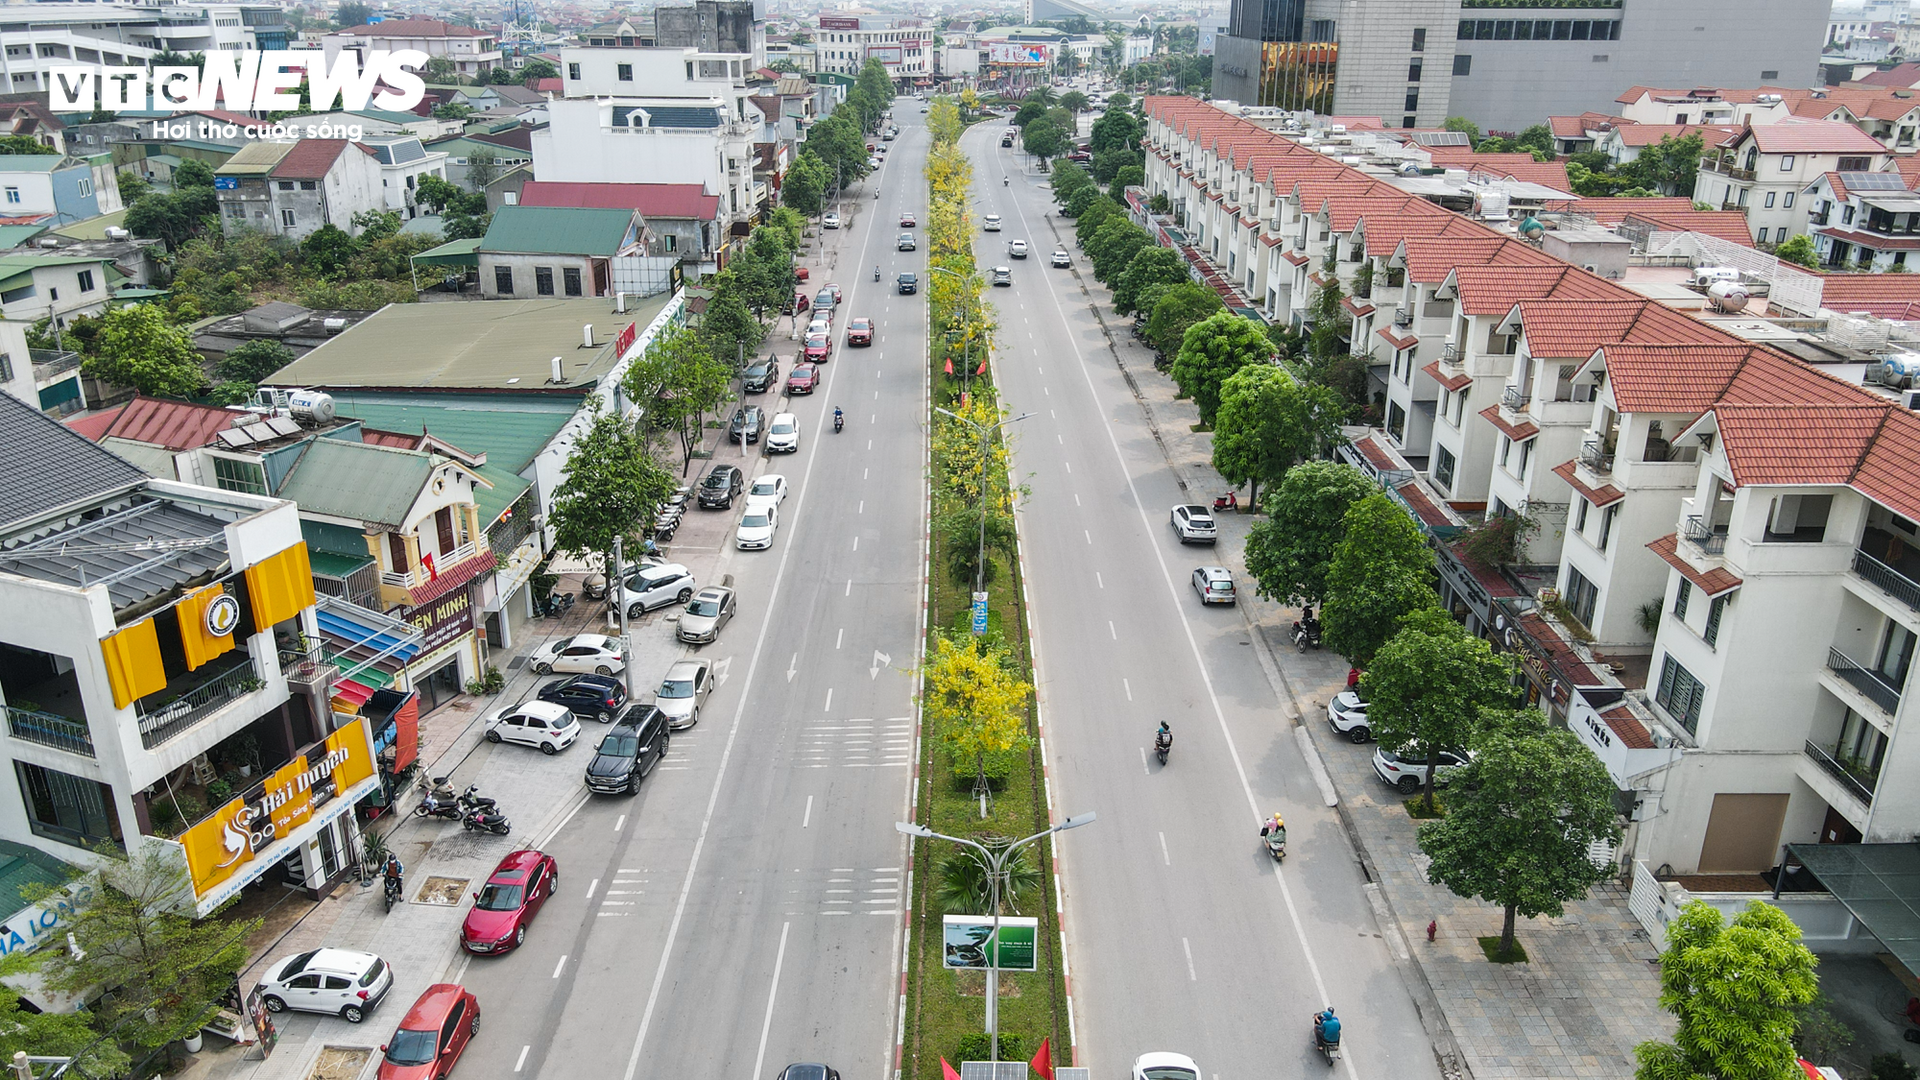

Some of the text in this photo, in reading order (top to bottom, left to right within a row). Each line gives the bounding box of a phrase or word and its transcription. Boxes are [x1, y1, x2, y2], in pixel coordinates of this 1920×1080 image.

[436, 593, 468, 623] MINH
[261, 781, 294, 818] Hải
[296, 747, 350, 794] Duyên
[278, 815, 291, 828] Tỏa
[292, 803, 308, 819] Sáng
[326, 782, 337, 793] Tin
